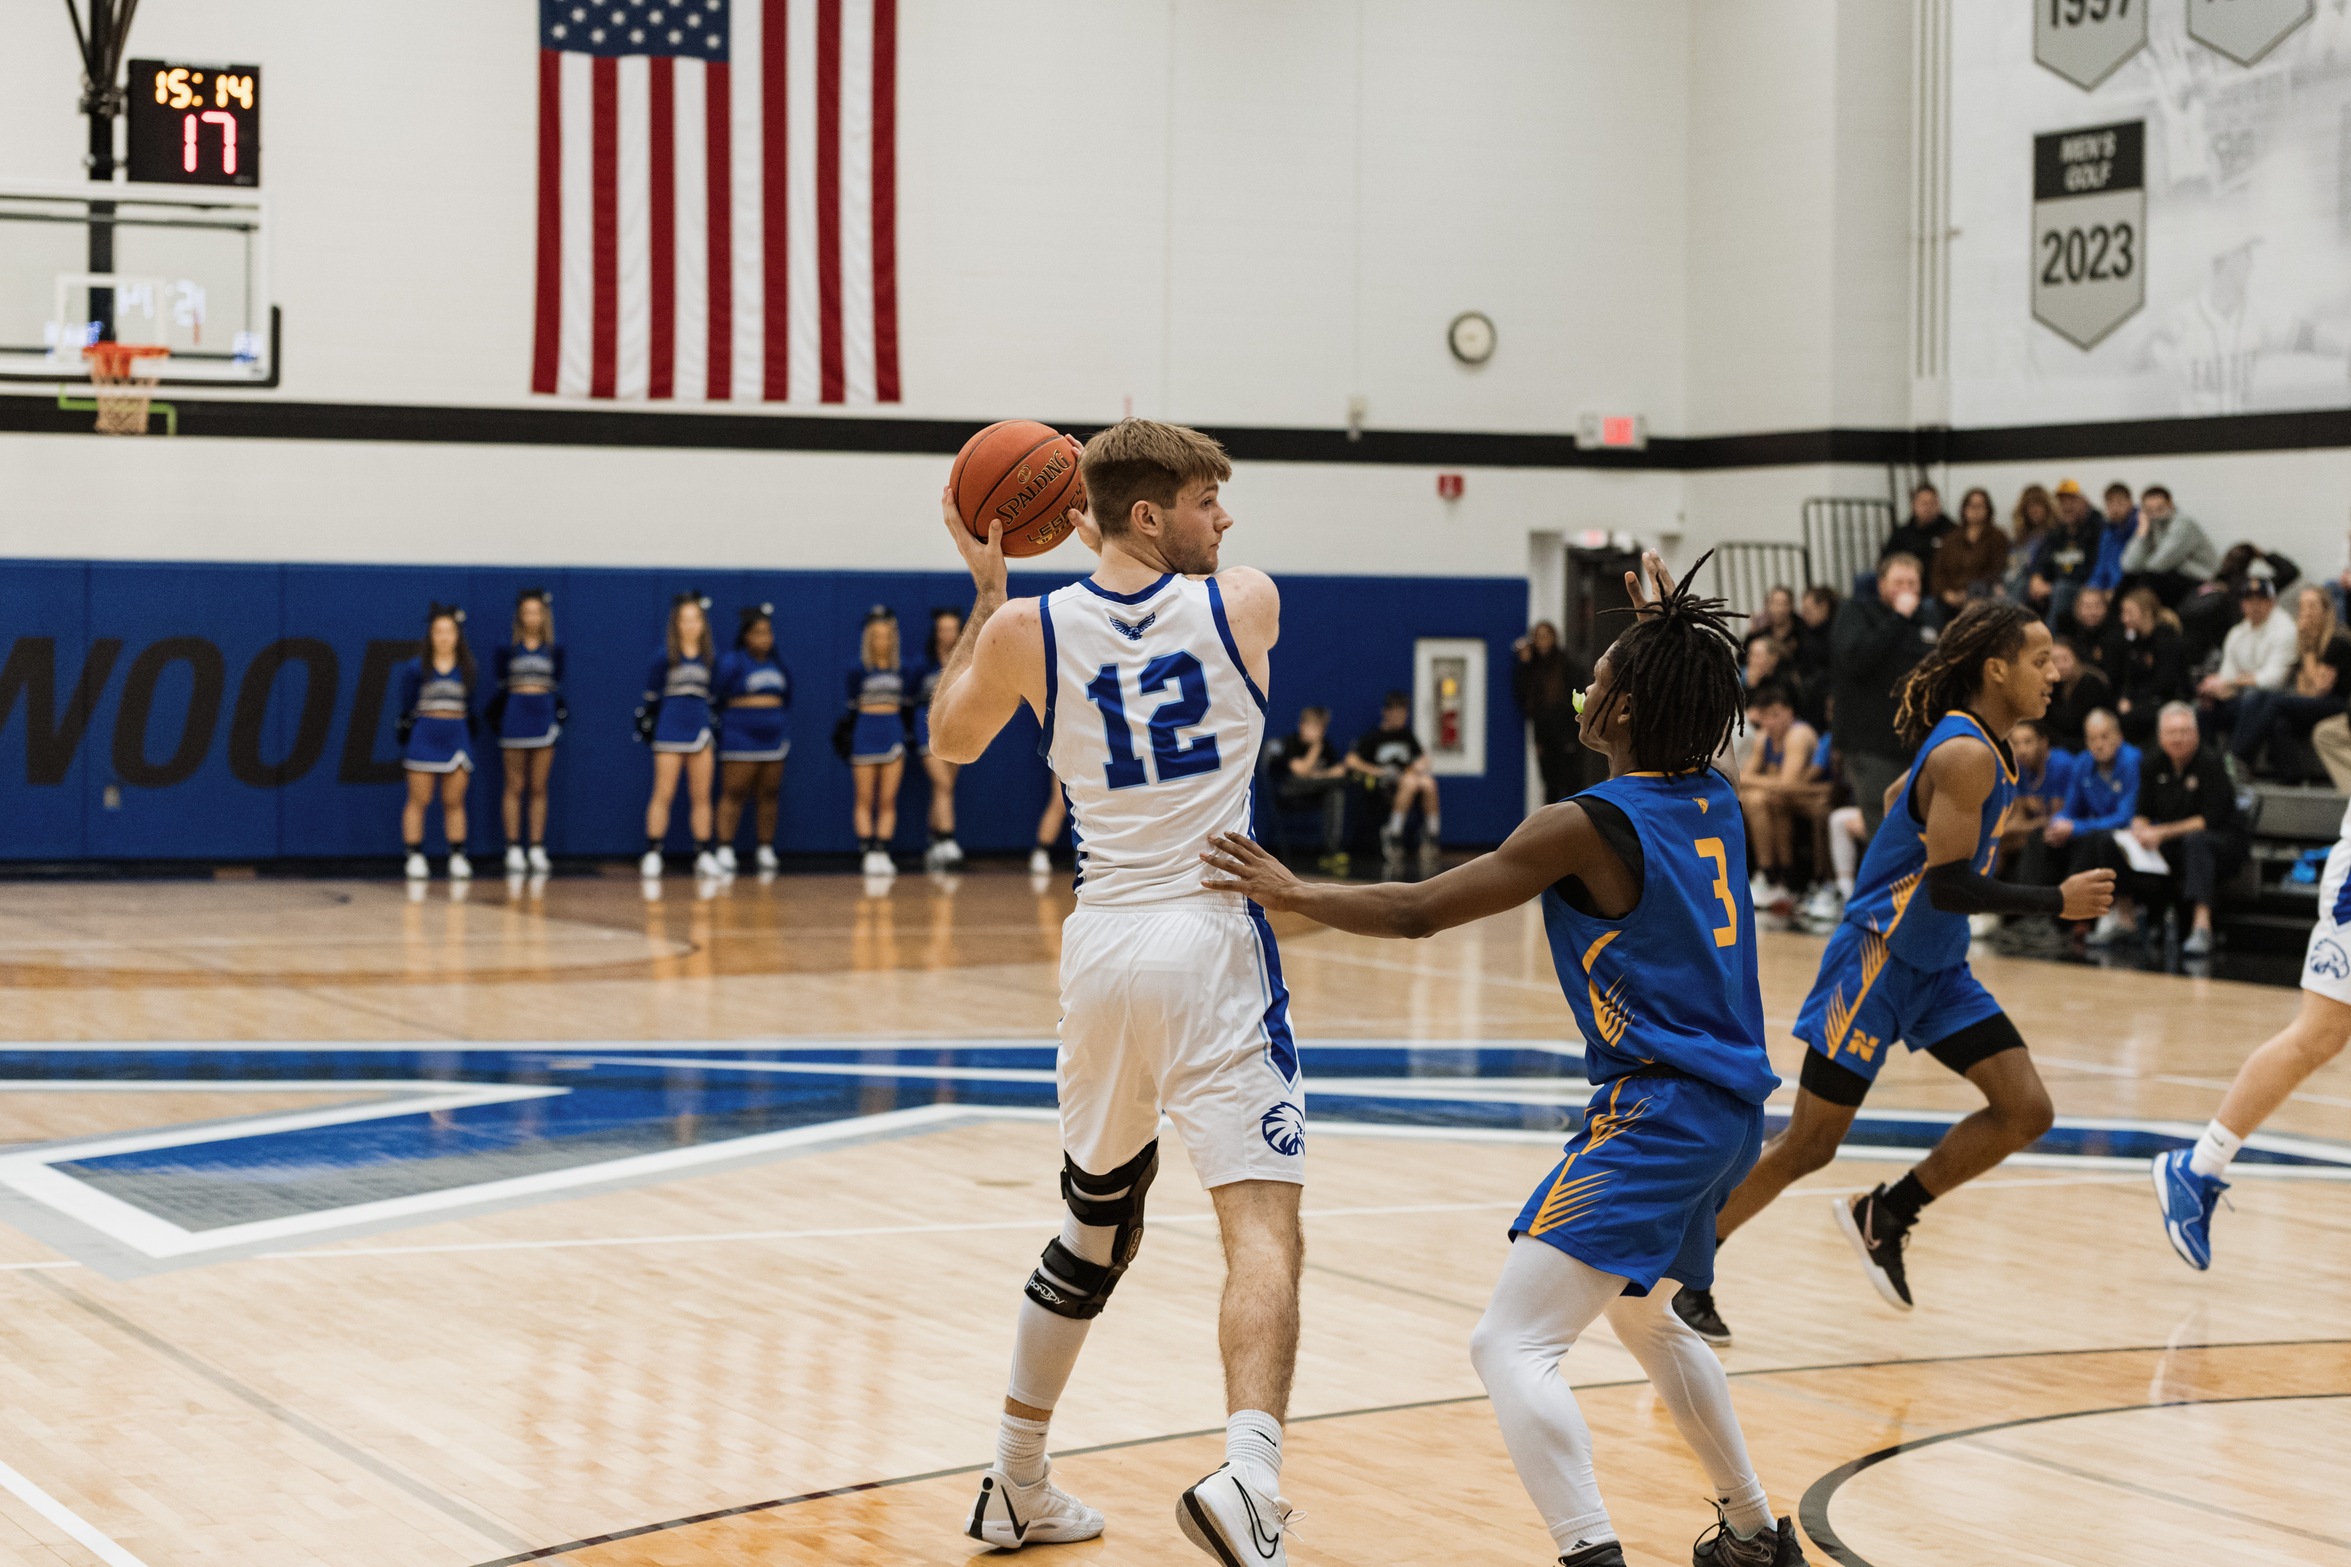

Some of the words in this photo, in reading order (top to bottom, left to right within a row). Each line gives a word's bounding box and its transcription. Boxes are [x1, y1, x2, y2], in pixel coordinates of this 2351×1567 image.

[155, 68, 254, 110] 15:14
[183, 110, 236, 175] 17
[2065, 160, 2113, 192] GOLF
[2042, 221, 2134, 288] 2023
[995, 449, 1071, 526] SPALDING
[1085, 648, 1222, 791] 12
[1694, 837, 1737, 948] 3
[1029, 1279, 1065, 1305] DONJOY
